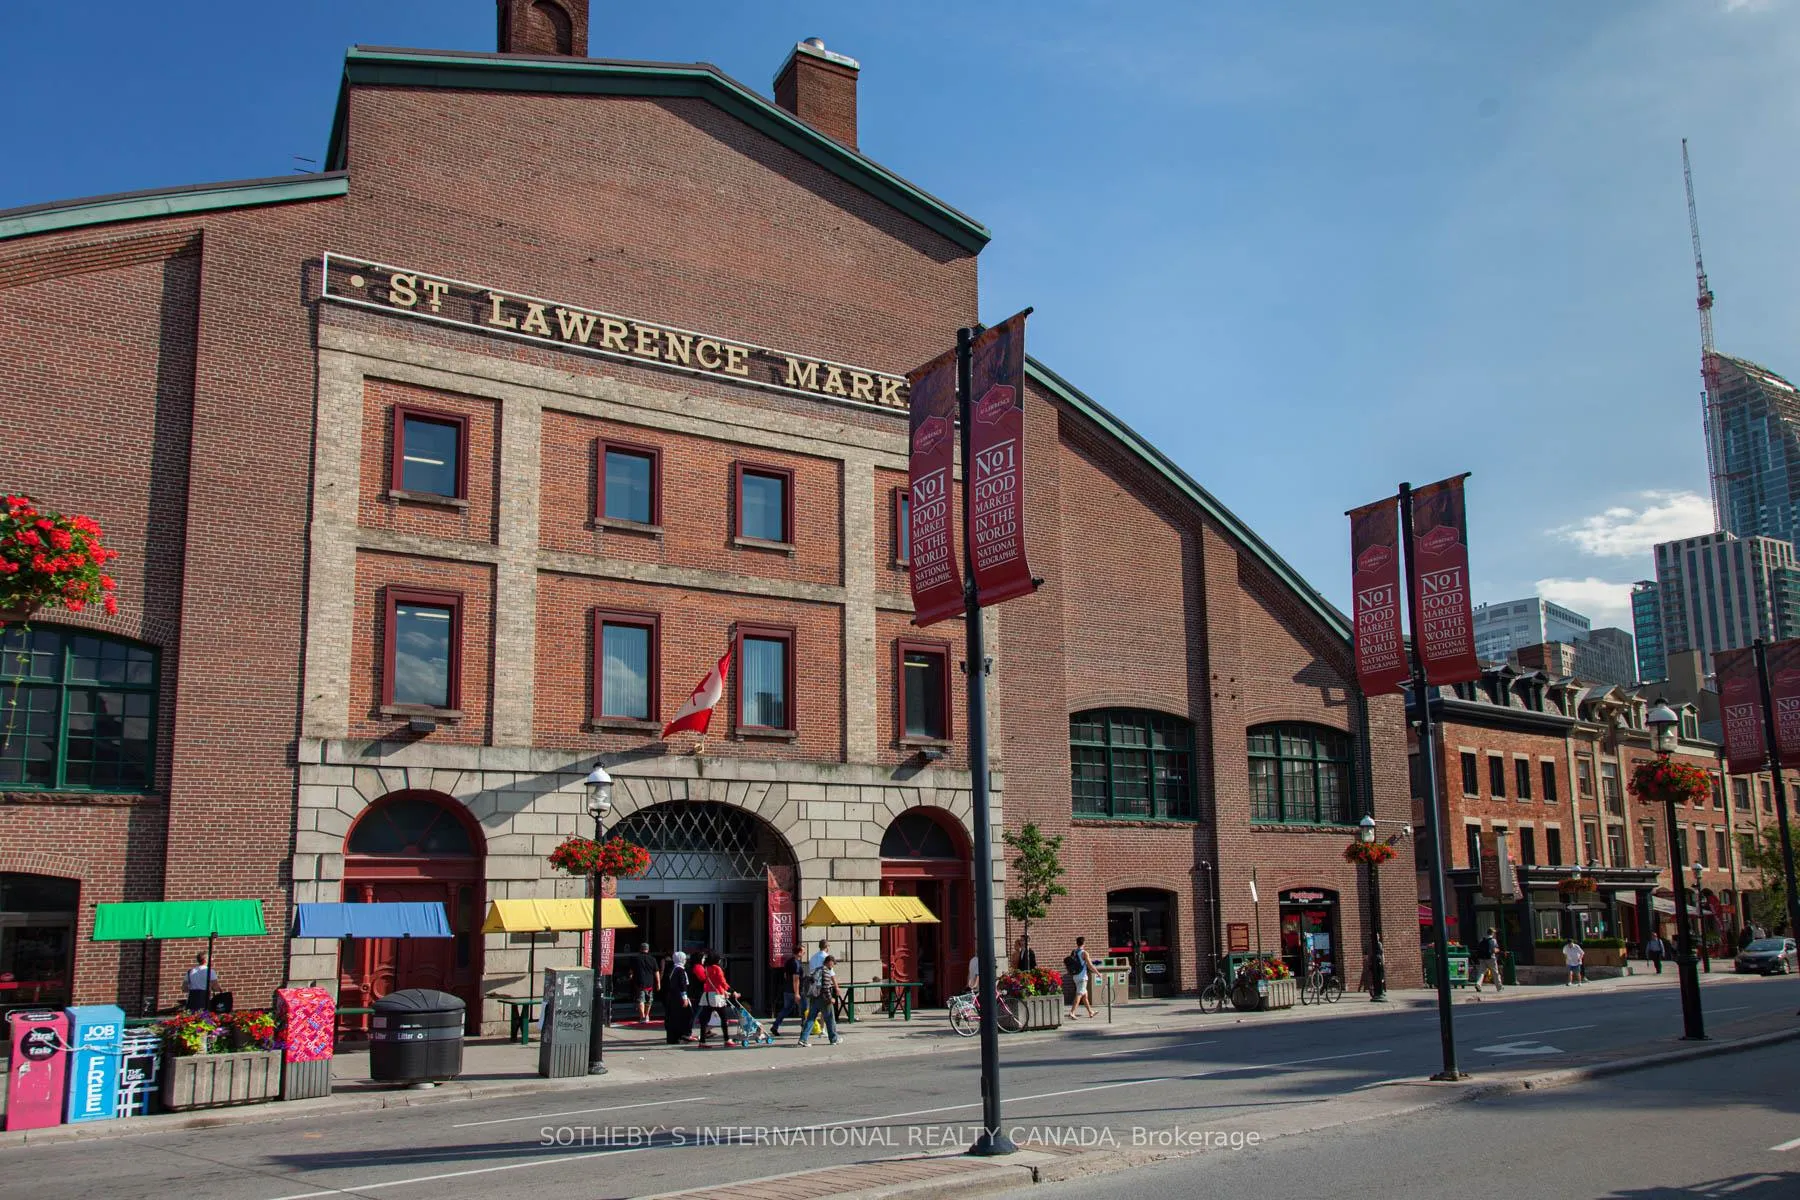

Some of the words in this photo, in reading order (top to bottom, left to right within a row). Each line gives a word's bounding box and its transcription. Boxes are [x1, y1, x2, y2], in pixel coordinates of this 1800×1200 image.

[389, 273, 448, 312] ST
[488, 291, 749, 376] LAWRENCE
[785, 356, 910, 409] MARK
[976, 475, 1015, 502] FOOD
[976, 490, 1015, 515] MARKET
[913, 502, 946, 529] FOOD
[976, 516, 988, 532] IN
[990, 506, 1016, 526] THE
[913, 516, 946, 540] MARKET
[976, 521, 1016, 544] WORLD
[913, 542, 924, 557] IN
[925, 531, 947, 550] THE
[977, 538, 1017, 559] NATIONAL
[914, 545, 948, 568] WORLD
[978, 547, 1018, 568] GEOGRAPHIC
[915, 562, 951, 582] NATIONAL
[915, 571, 953, 590] GEOGRAPHIC
[1422, 592, 1464, 612] FOOD
[1423, 603, 1464, 620] MARKET
[1359, 608, 1394, 626] FOOD
[1359, 619, 1394, 635] MARKET
[1424, 621, 1436, 633] IN
[1439, 615, 1466, 630] THE
[1360, 636, 1371, 647] IN
[1375, 630, 1397, 644] THE
[1425, 626, 1466, 642] WORLD
[1361, 640, 1397, 656] WORLD
[1426, 638, 1468, 653] NATIONAL
[1361, 652, 1400, 666] NATIONAL
[1727, 719, 1756, 729] FOOD
[85, 1025, 115, 1037] JOB
[86, 1056, 104, 1112] FREE
